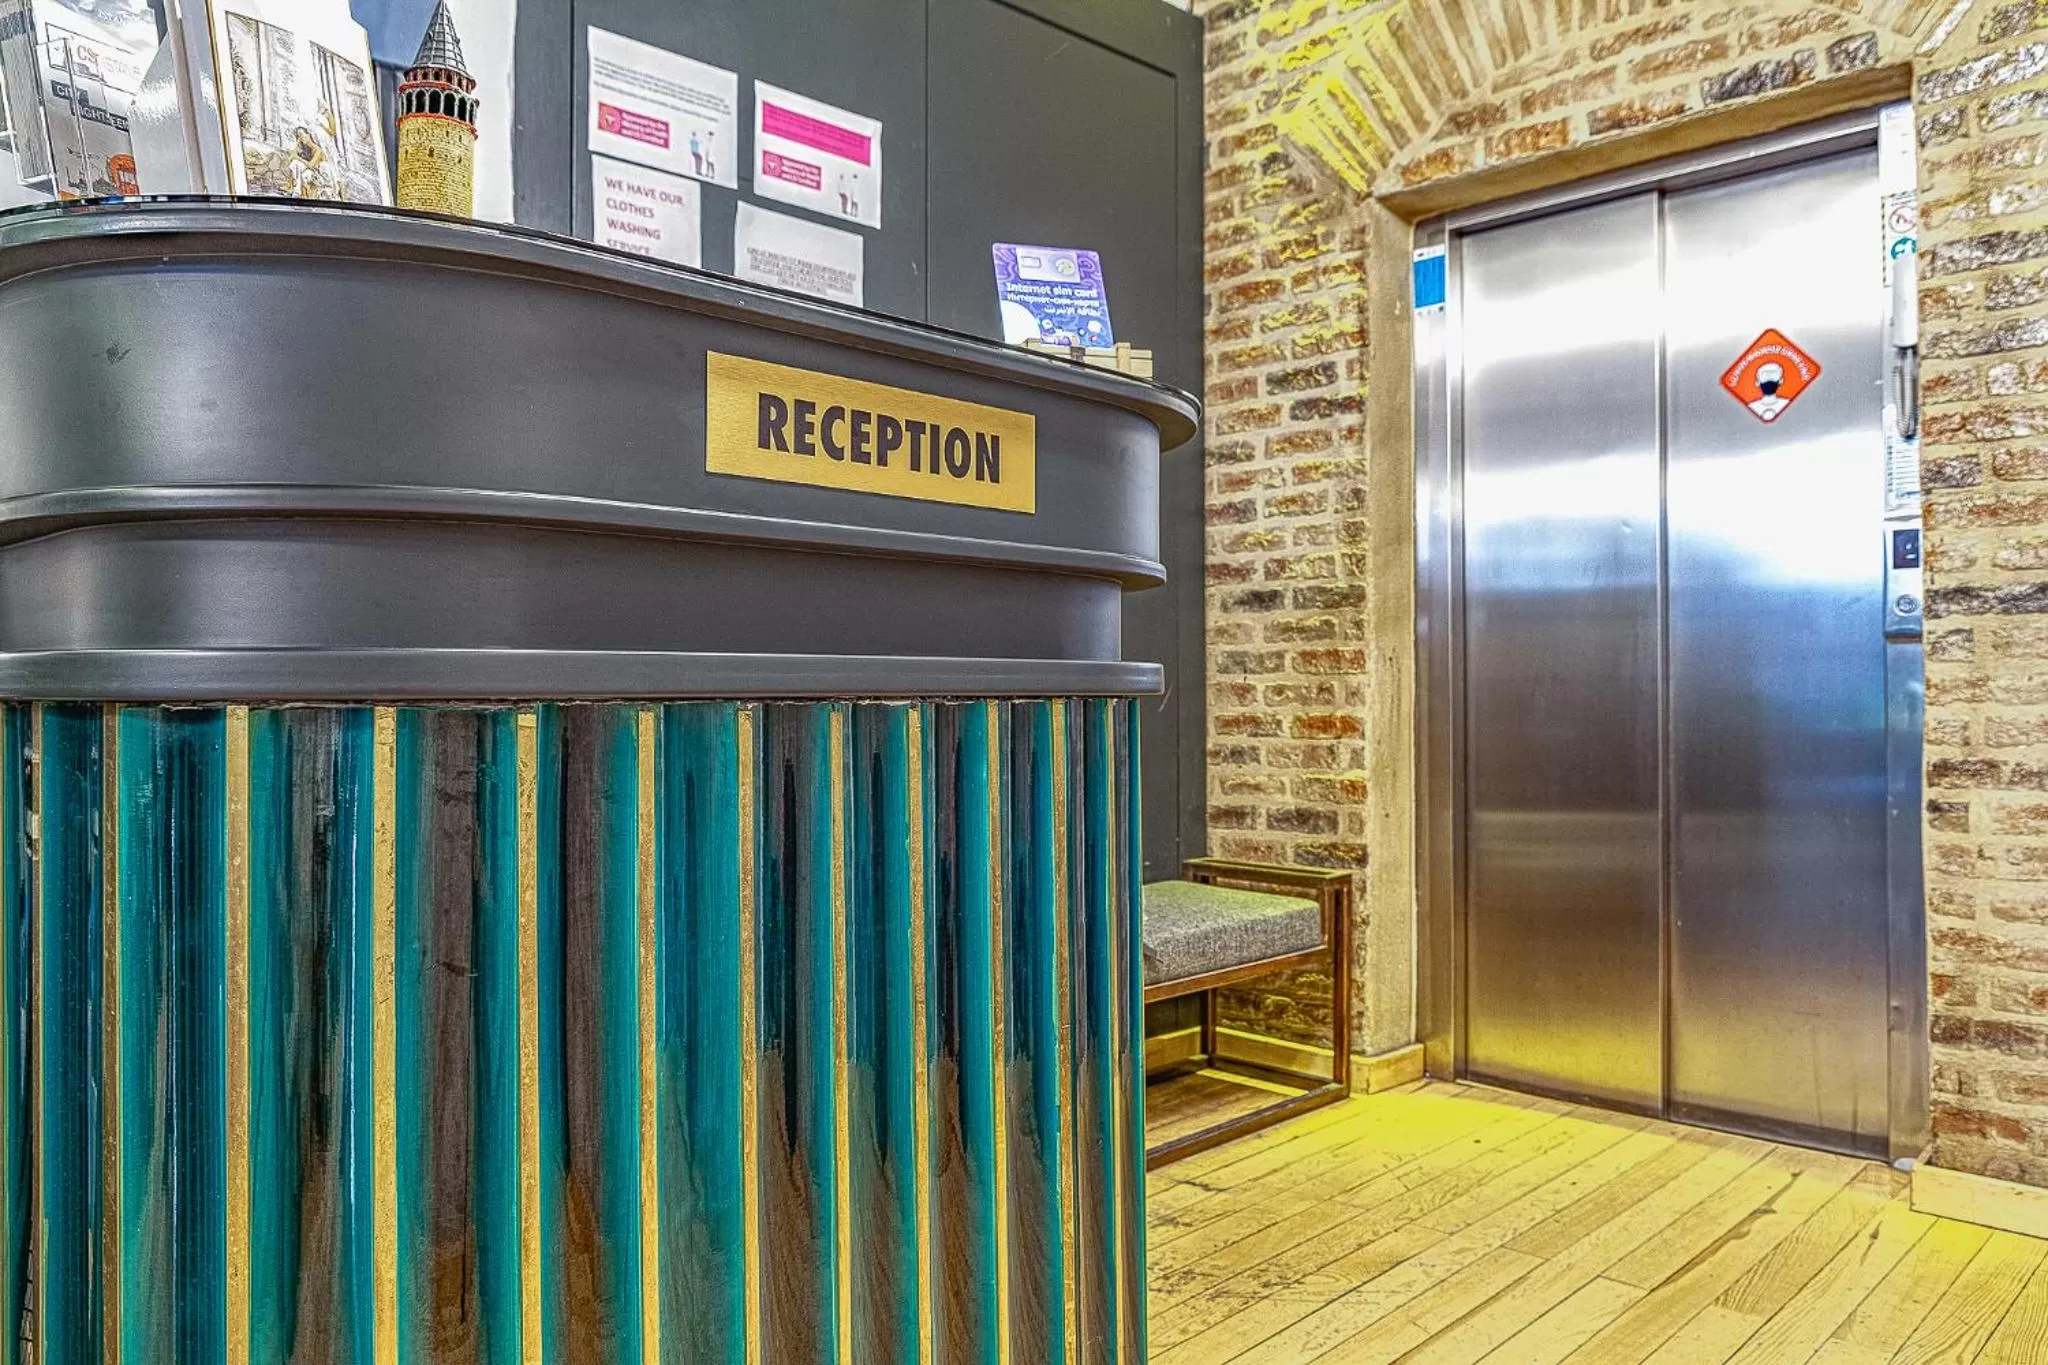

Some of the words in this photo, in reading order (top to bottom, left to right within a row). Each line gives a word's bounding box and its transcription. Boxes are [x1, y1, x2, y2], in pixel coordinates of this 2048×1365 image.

[605, 176, 623, 192] WE
[627, 182, 657, 201] HAVE
[659, 190, 685, 207] OUR
[605, 197, 655, 219] CLOTHES
[606, 218, 662, 241] WASHING
[1006, 282, 1052, 294] Internet
[1074, 289, 1098, 298] card
[757, 392, 1000, 484] RECEPTION
